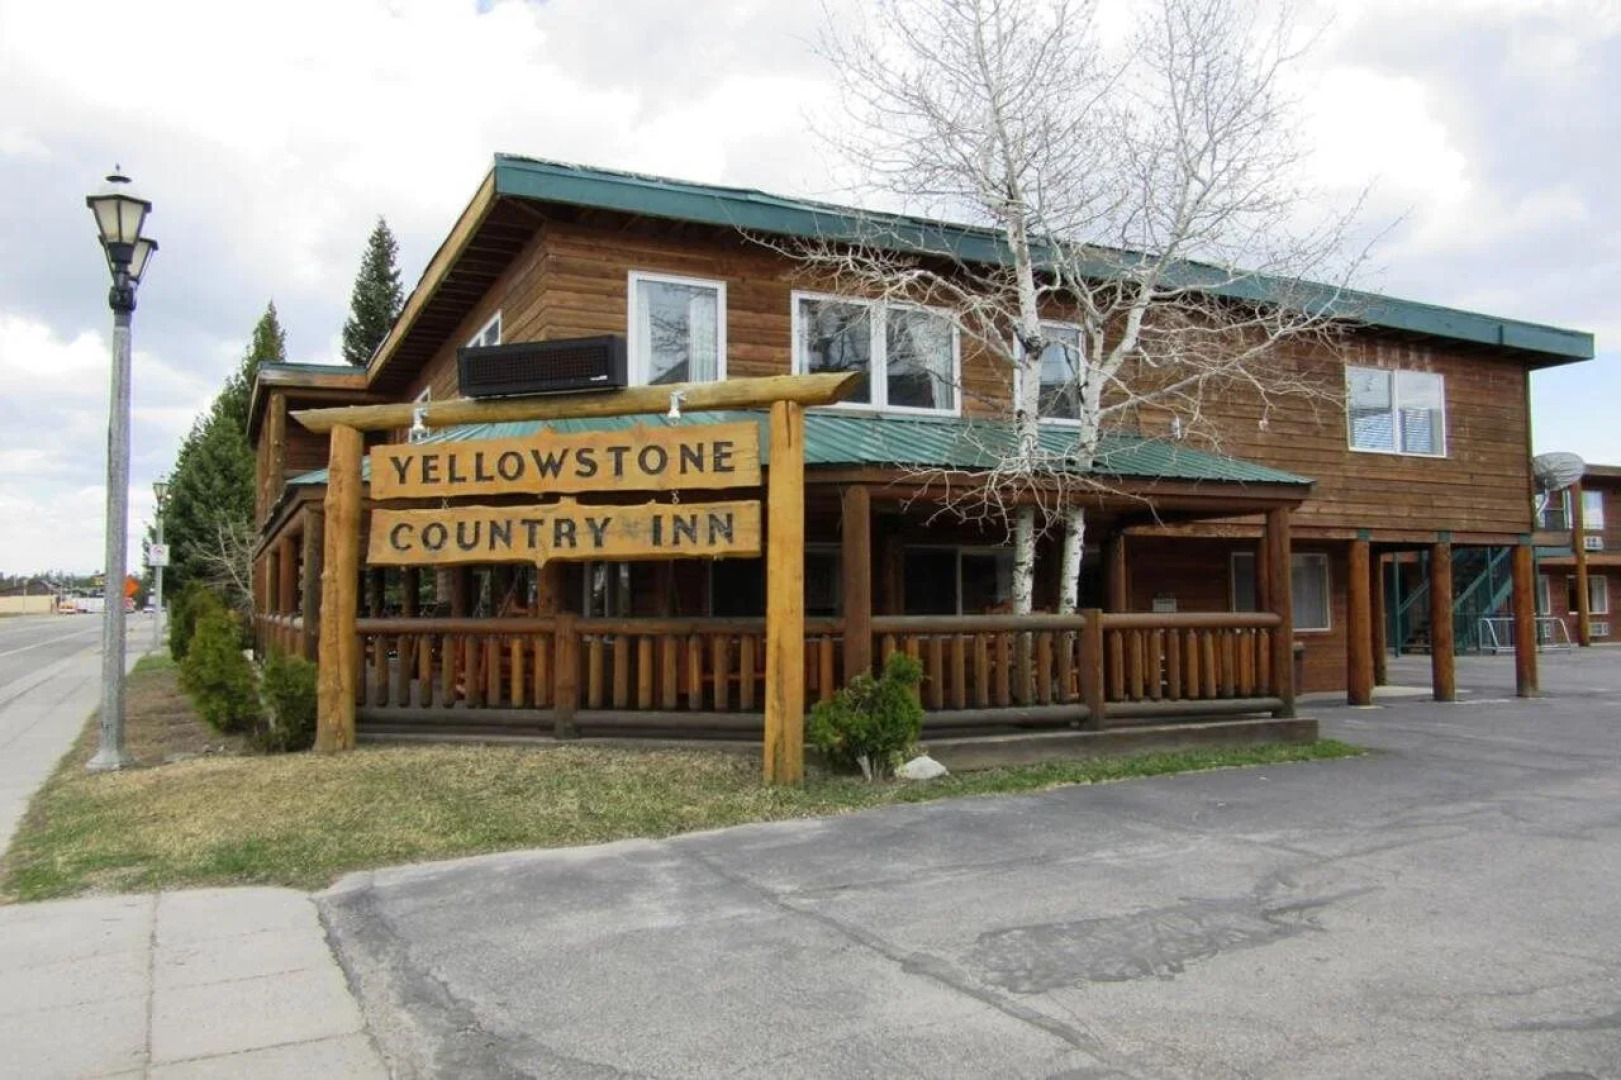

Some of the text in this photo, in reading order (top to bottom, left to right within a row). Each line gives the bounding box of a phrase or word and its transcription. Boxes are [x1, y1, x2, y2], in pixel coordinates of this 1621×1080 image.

[390, 441, 735, 484] YELLOWSTONE
[390, 513, 734, 551] COUNTRY INN
